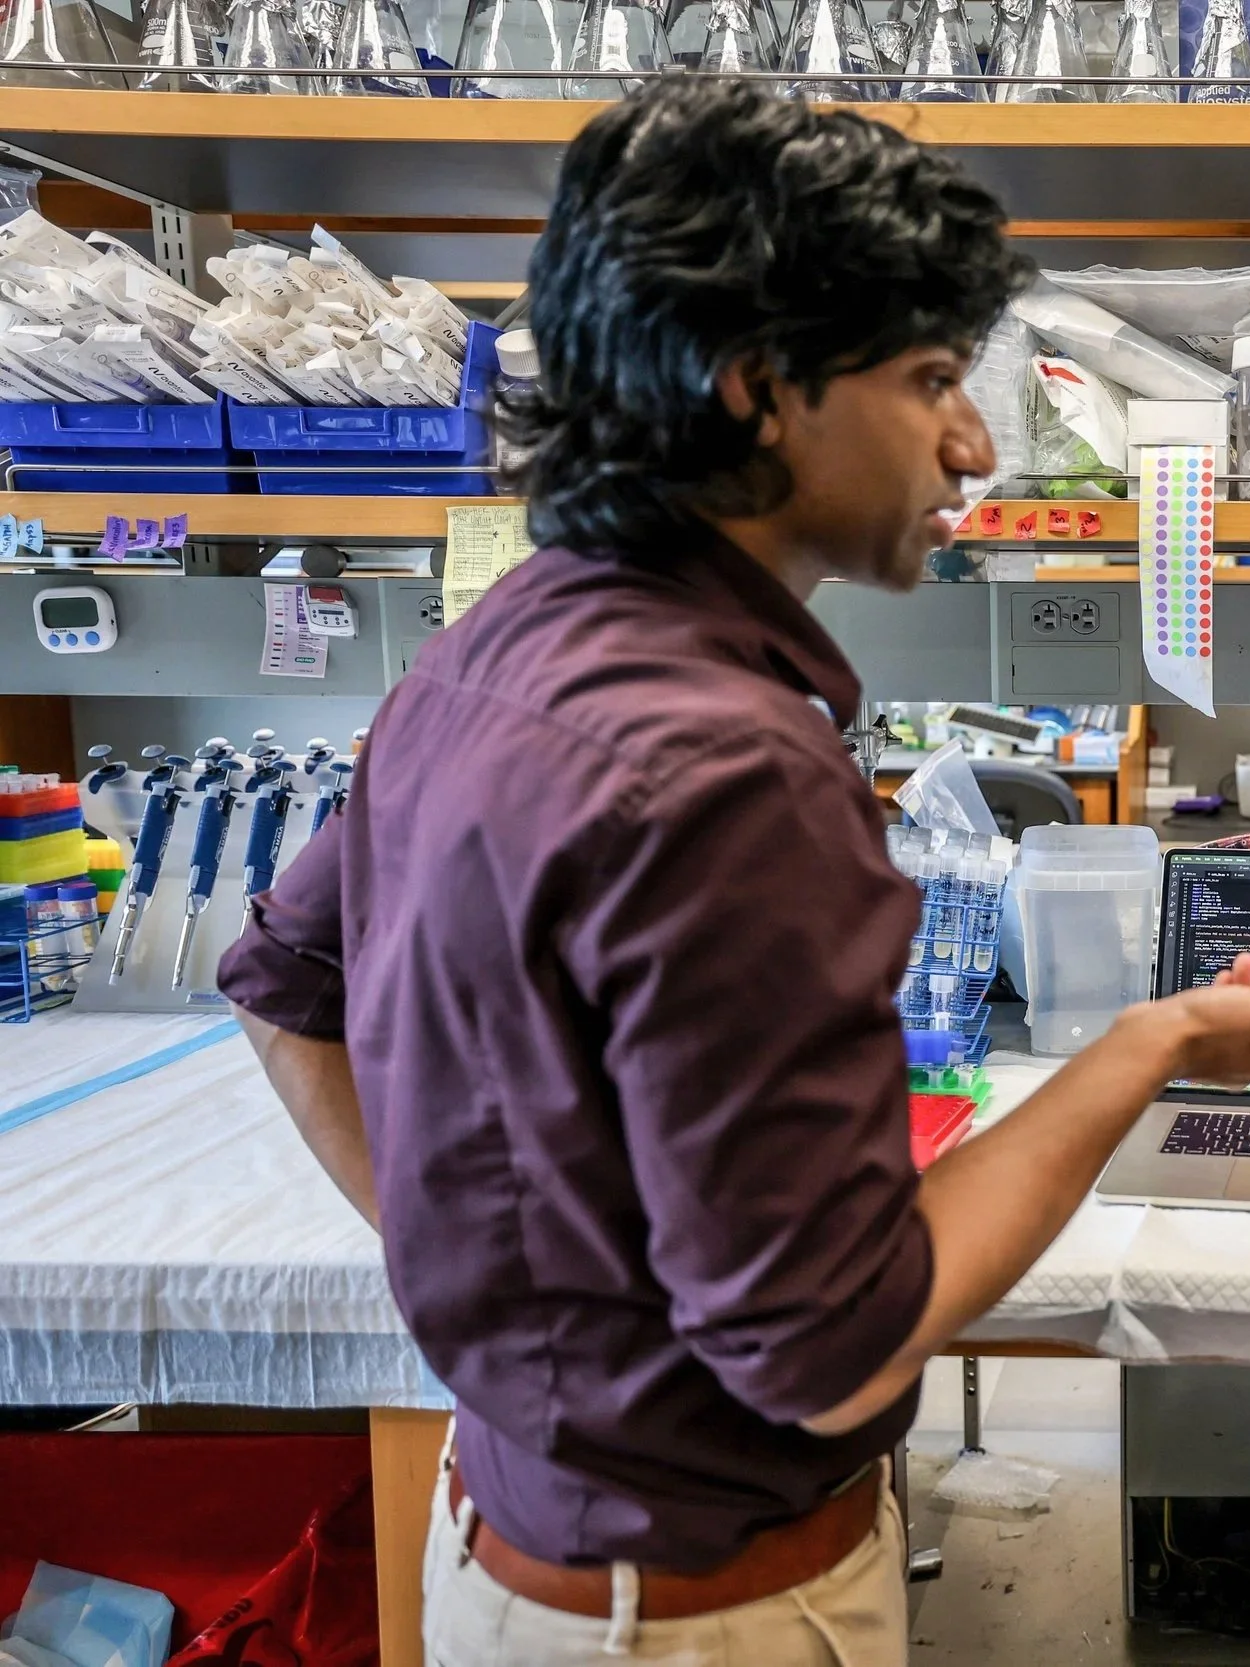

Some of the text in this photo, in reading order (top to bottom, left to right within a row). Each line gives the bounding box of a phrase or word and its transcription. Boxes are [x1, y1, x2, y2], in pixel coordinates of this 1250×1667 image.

[1195, 85, 1230, 96] applied
[159, 373, 187, 396] avantor
[242, 370, 270, 391] avantor
